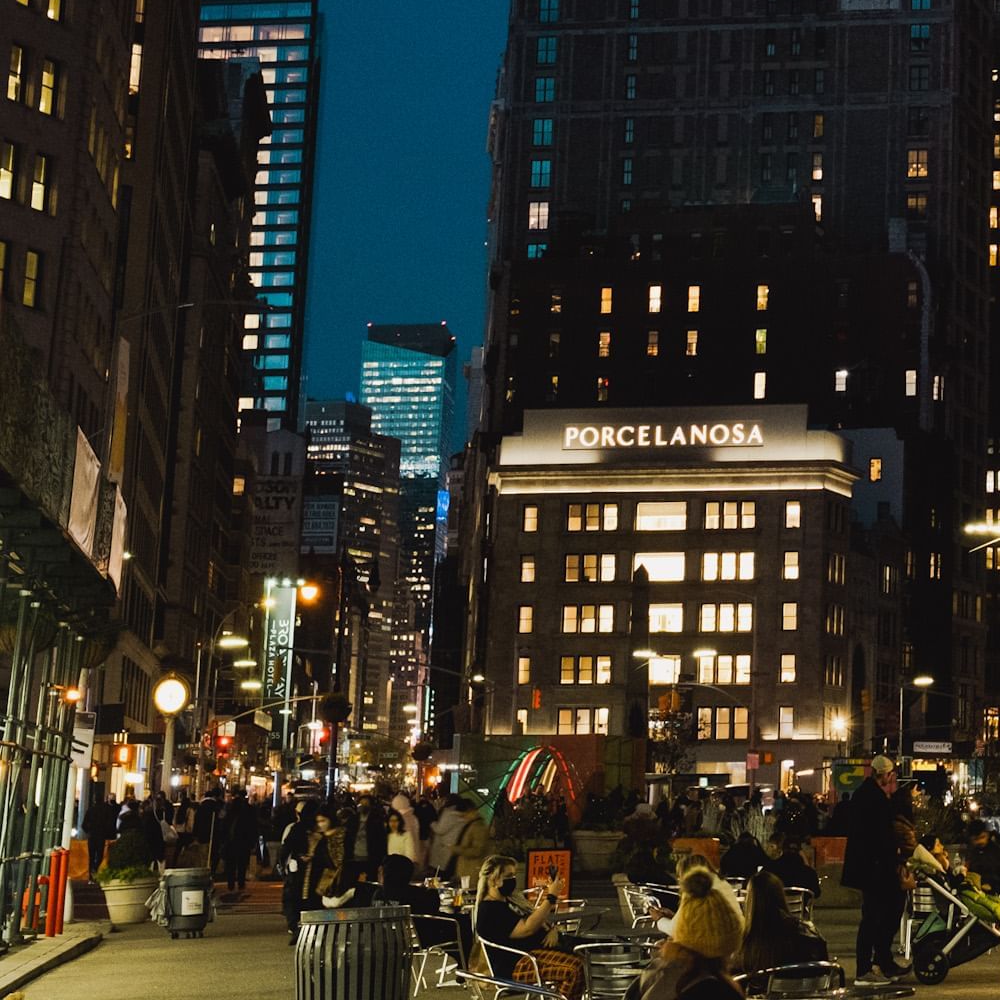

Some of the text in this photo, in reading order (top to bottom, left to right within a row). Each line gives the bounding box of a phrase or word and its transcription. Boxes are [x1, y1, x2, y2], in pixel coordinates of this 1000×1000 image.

[564, 423, 764, 447] PORCELANOSA
[255, 496, 296, 510] ALTY
[266, 628, 277, 690] PLAZA HOTEL
[533, 855, 560, 865] FLAT
[533, 866, 557, 876] IRO
